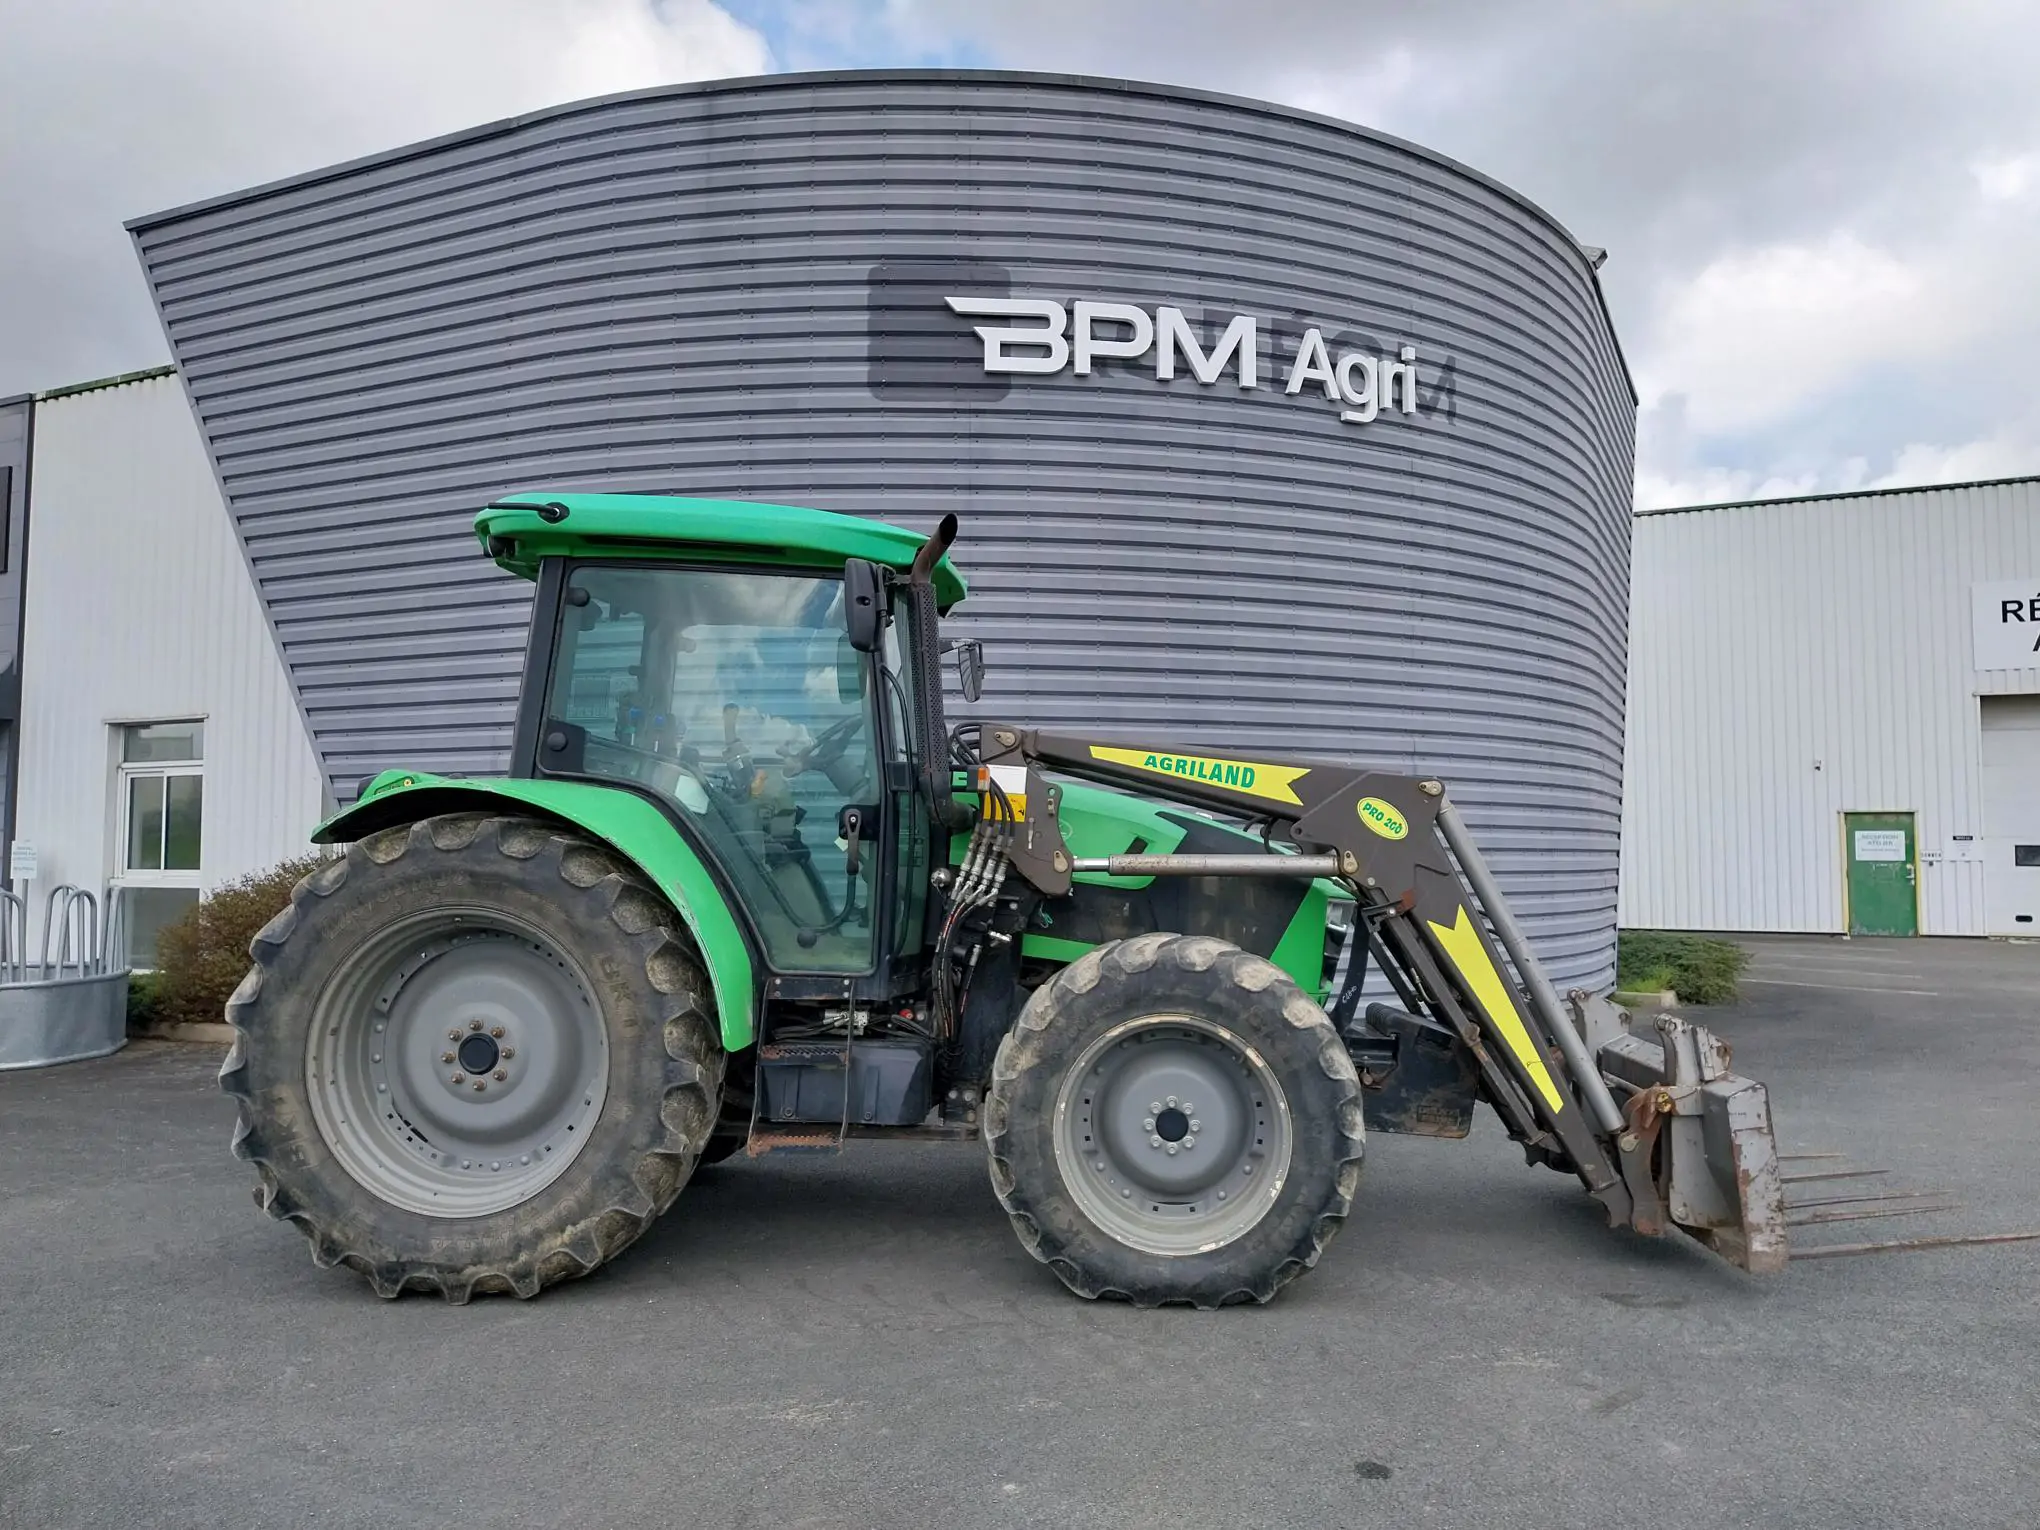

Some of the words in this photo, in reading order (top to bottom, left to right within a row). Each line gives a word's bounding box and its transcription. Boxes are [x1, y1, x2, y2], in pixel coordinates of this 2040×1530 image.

[943, 296, 1257, 390] BPM
[1284, 327, 1417, 424] Agri
[1143, 754, 1256, 789] AGRILAND
[1362, 802, 1385, 822] PRO
